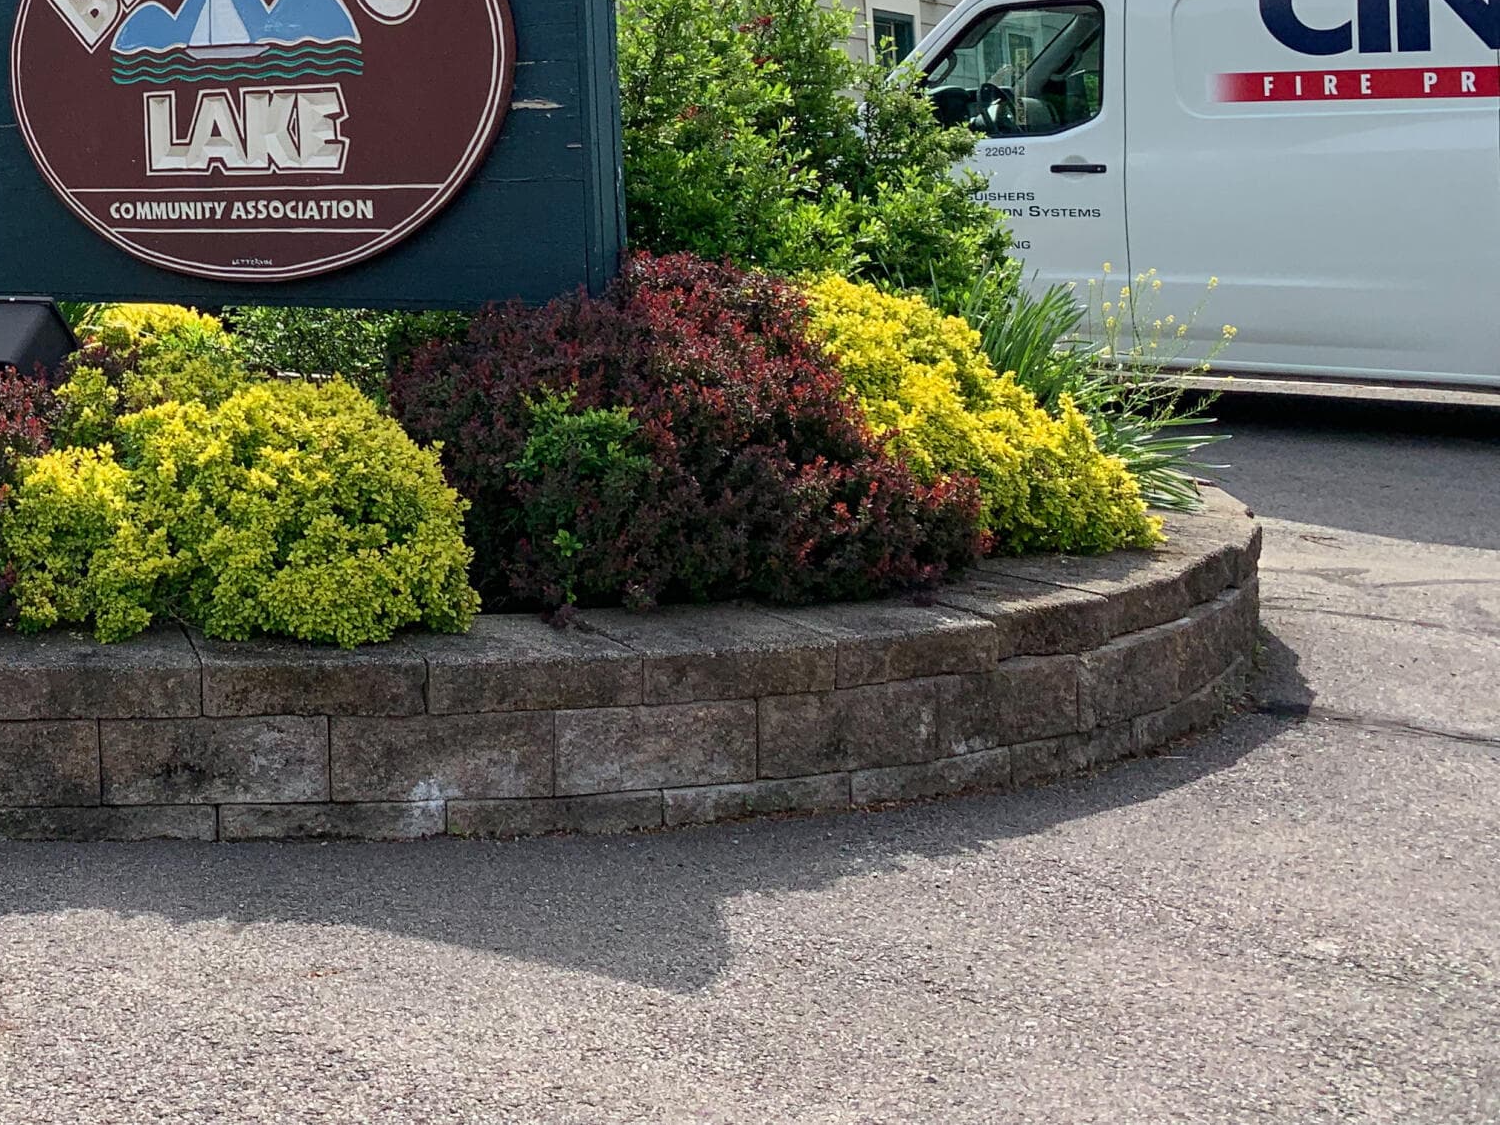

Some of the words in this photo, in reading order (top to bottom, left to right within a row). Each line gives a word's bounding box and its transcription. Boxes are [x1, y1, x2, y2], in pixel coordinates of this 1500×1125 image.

[1263, 74, 1372, 96] FIRE
[143, 83, 350, 175] LAKE
[985, 146, 1025, 157] 226042
[109, 201, 227, 220] COMMUNITY
[230, 199, 374, 220] ASSOCIATION
